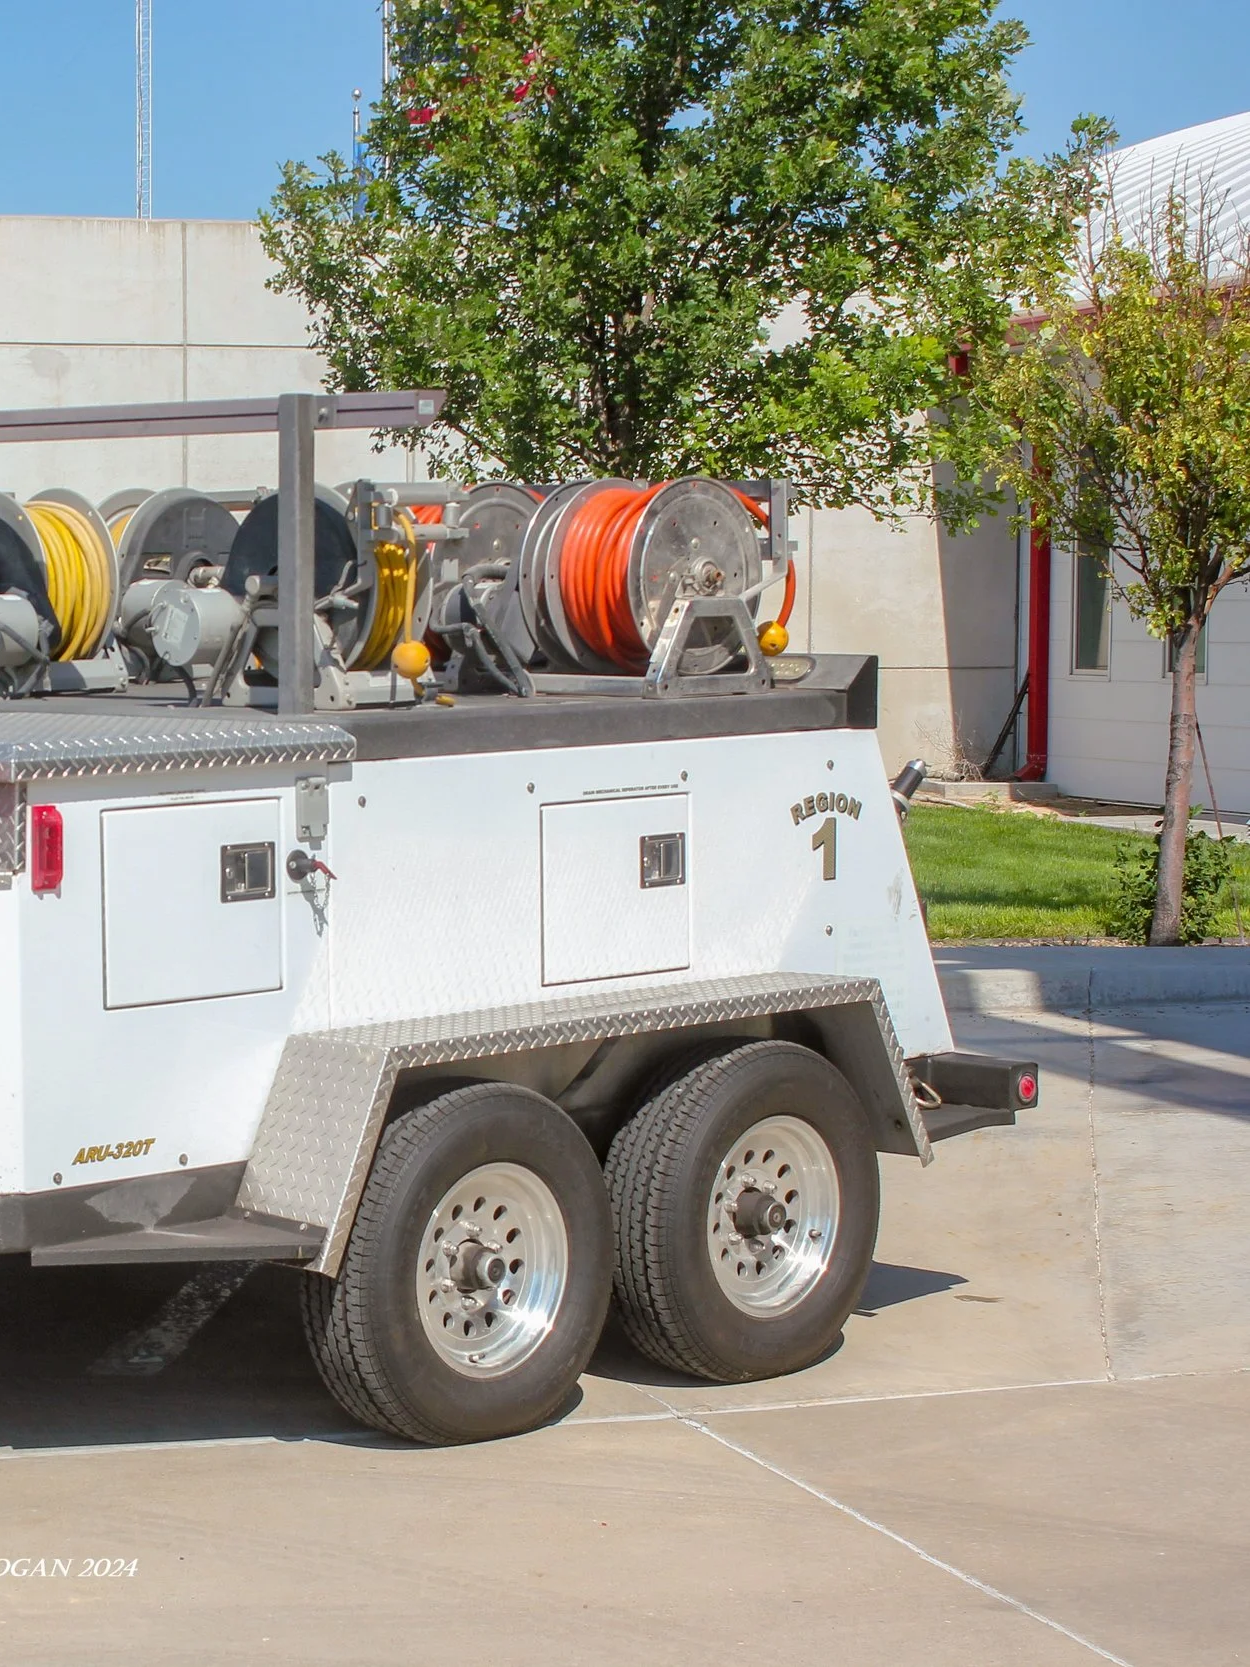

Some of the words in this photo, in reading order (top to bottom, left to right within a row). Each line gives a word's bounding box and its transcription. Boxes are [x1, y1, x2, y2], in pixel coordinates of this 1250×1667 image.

[790, 791, 863, 826] REGION
[812, 817, 837, 881] 1
[71, 1138, 156, 1166] ARU-320T
